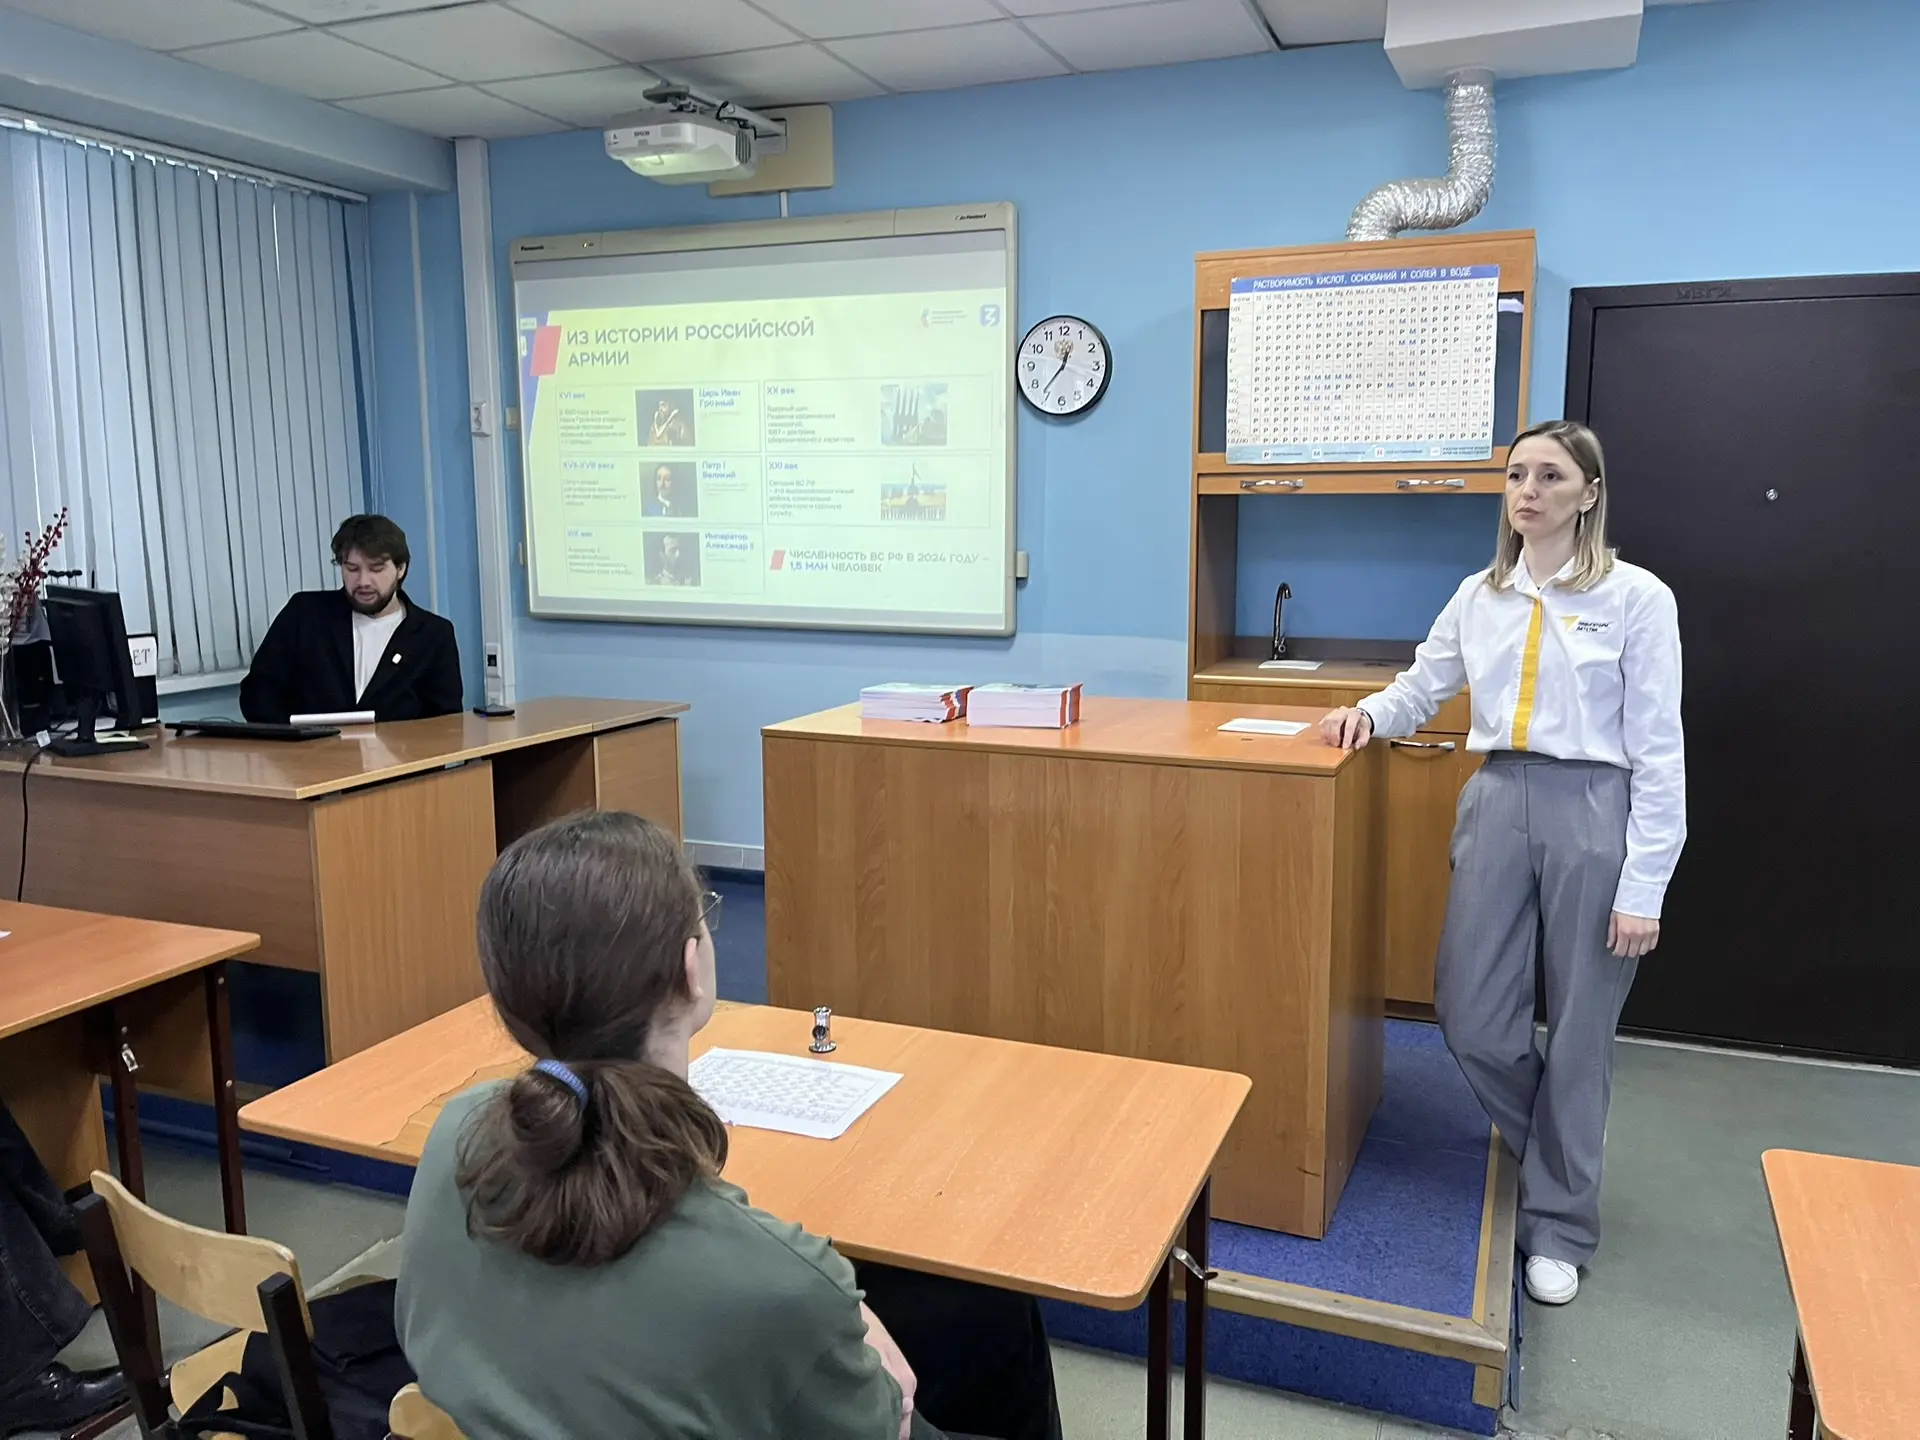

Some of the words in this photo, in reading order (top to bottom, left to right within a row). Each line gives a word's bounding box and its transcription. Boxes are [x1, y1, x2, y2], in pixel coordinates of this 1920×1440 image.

[1253, 278, 1314, 290] РАСТВОРИМОСТЬ
[1316, 274, 1348, 286] КИСЛОТ,
[1350, 270, 1397, 282] ОСНОВАНИЙ
[1410, 268, 1436, 279] СОЛЕЙ
[1450, 266, 1472, 278] ВОДЕ
[567, 329, 589, 346] ИЗ
[595, 326, 678, 344] ИСТОРИИ
[686, 316, 814, 341] РОССИЙСКОЙ
[1044, 331, 1053, 341] 11
[1078, 330, 1083, 340] 1
[1058, 326, 1070, 336] 12
[1032, 344, 1044, 354] 10
[1088, 343, 1096, 353] 2
[568, 351, 630, 368] АРМИИ
[1027, 361, 1036, 371] 9
[1092, 360, 1100, 371] 3
[1031, 379, 1039, 389] 8
[1086, 378, 1094, 388] 4
[767, 386, 778, 394] XX
[1044, 390, 1051, 401] 7
[1058, 396, 1066, 406] 6
[1074, 390, 1082, 400] 5
[769, 461, 782, 470] XXI
[705, 532, 748, 541] Император
[706, 541, 748, 550] Александр
[789, 550, 867, 561] ЧИСЛЕННОСТЬ
[870, 552, 885, 562] ВС
[888, 552, 903, 562] РФ
[907, 553, 914, 562] В
[917, 553, 946, 562] 2024
[949, 554, 980, 564] ГОДУ
[789, 562, 803, 572] 1,5
[805, 563, 828, 571] МЛН
[831, 563, 882, 573] ЧЕЛОВЕК
